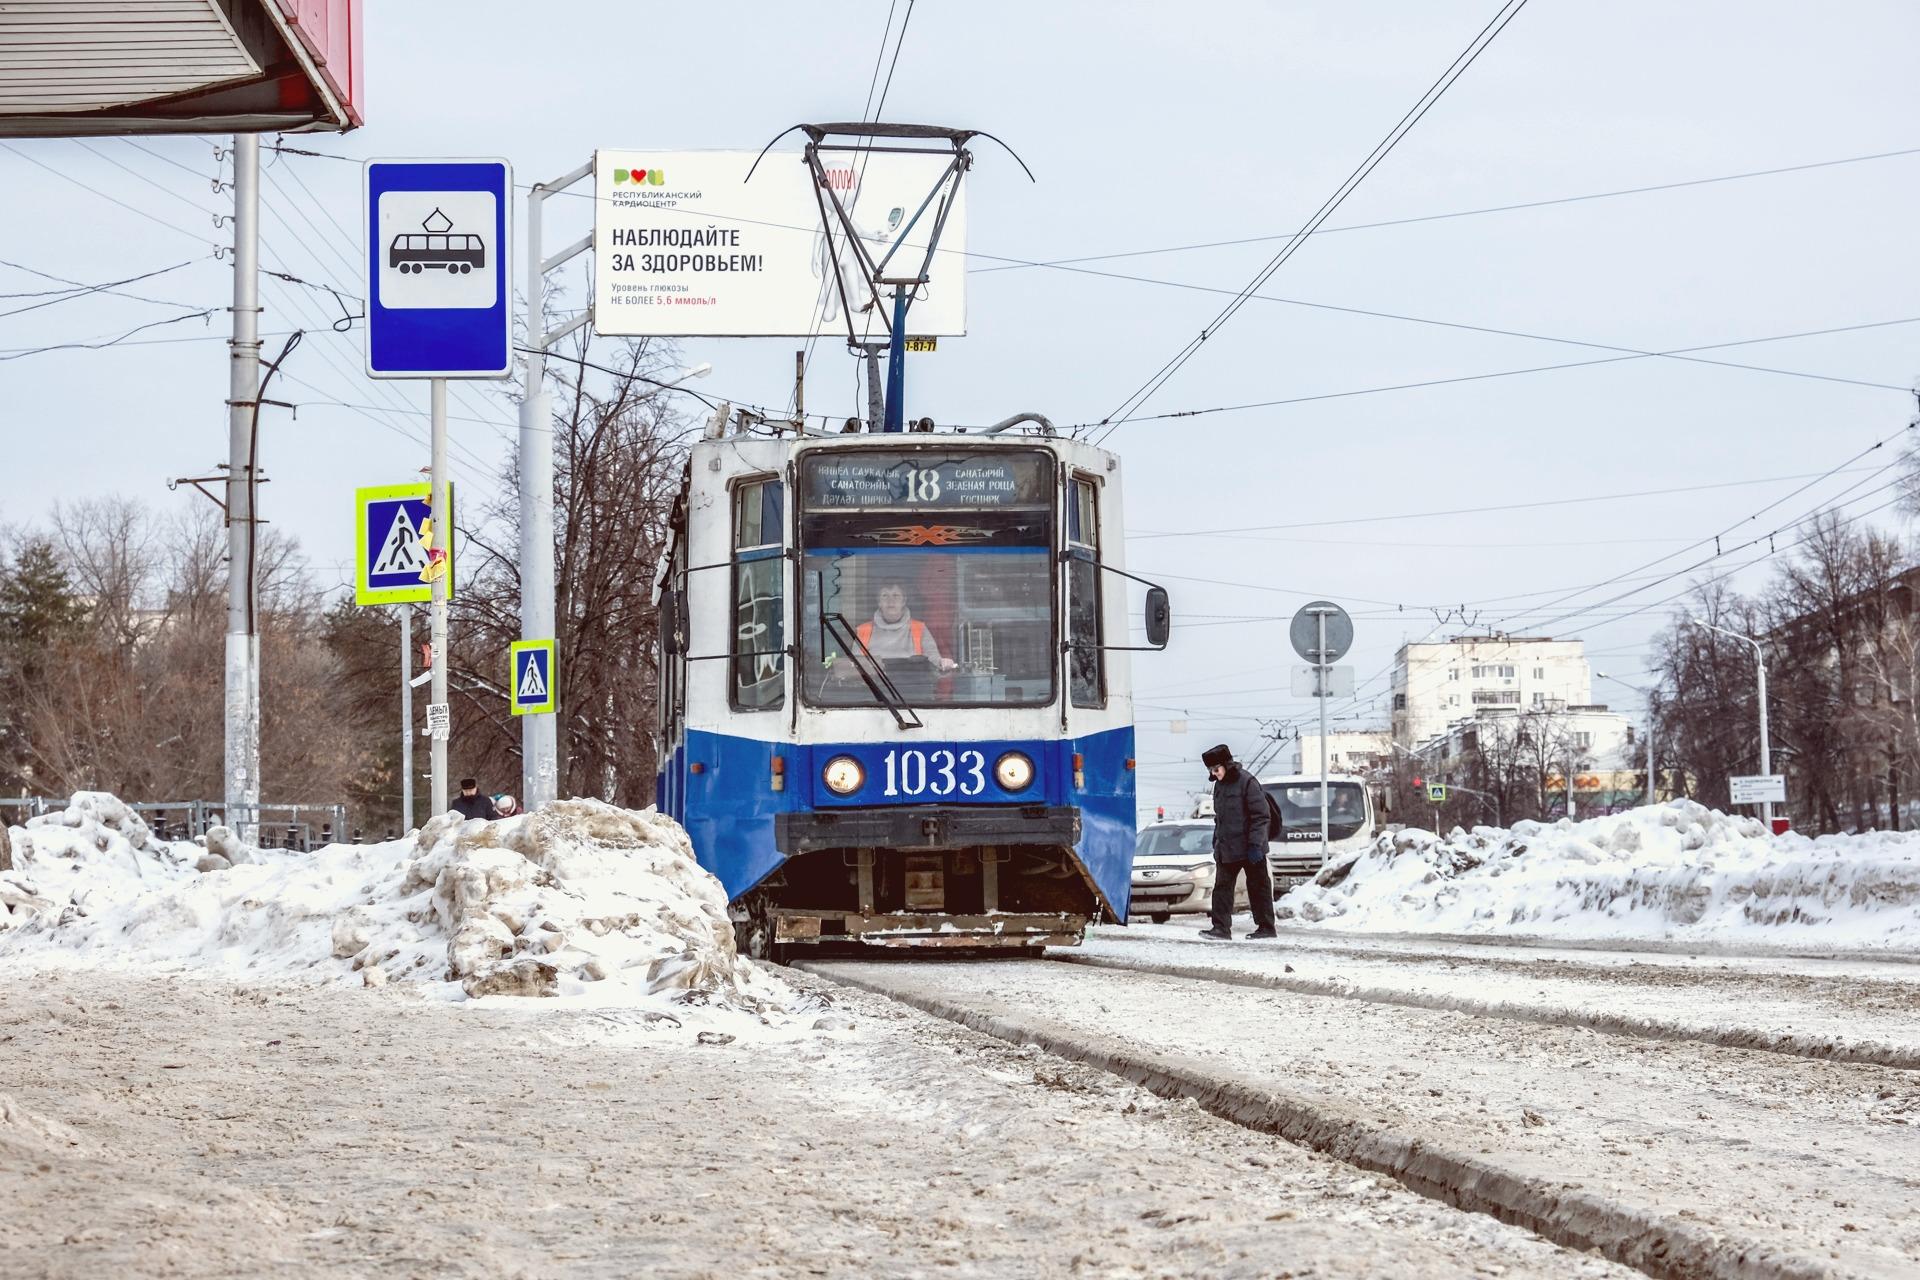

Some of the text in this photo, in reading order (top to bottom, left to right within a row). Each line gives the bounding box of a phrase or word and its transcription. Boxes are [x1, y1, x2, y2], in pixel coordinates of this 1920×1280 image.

[612, 189, 702, 199] РЕСПУБЛИКАНСКИЙ
[612, 200, 677, 208] КАРДИОЦЕНТР
[612, 224, 741, 249] НАБЛЮДАЙТЕ
[611, 253, 763, 274] ЗА ЗДОРОВЬЕМ!
[611, 283, 689, 293] Уровень глюкозы
[611, 295, 717, 306] НЕ БОЛЕЕ 5,6 ммоль/л
[955, 467, 1004, 478] САНАТОРИЙ
[906, 469, 941, 502] 18
[946, 481, 1016, 491] ЗЕЛЕНАЯ РОЩА
[960, 494, 1000, 504] ГОСЦИРК
[883, 750, 986, 796] 1033
